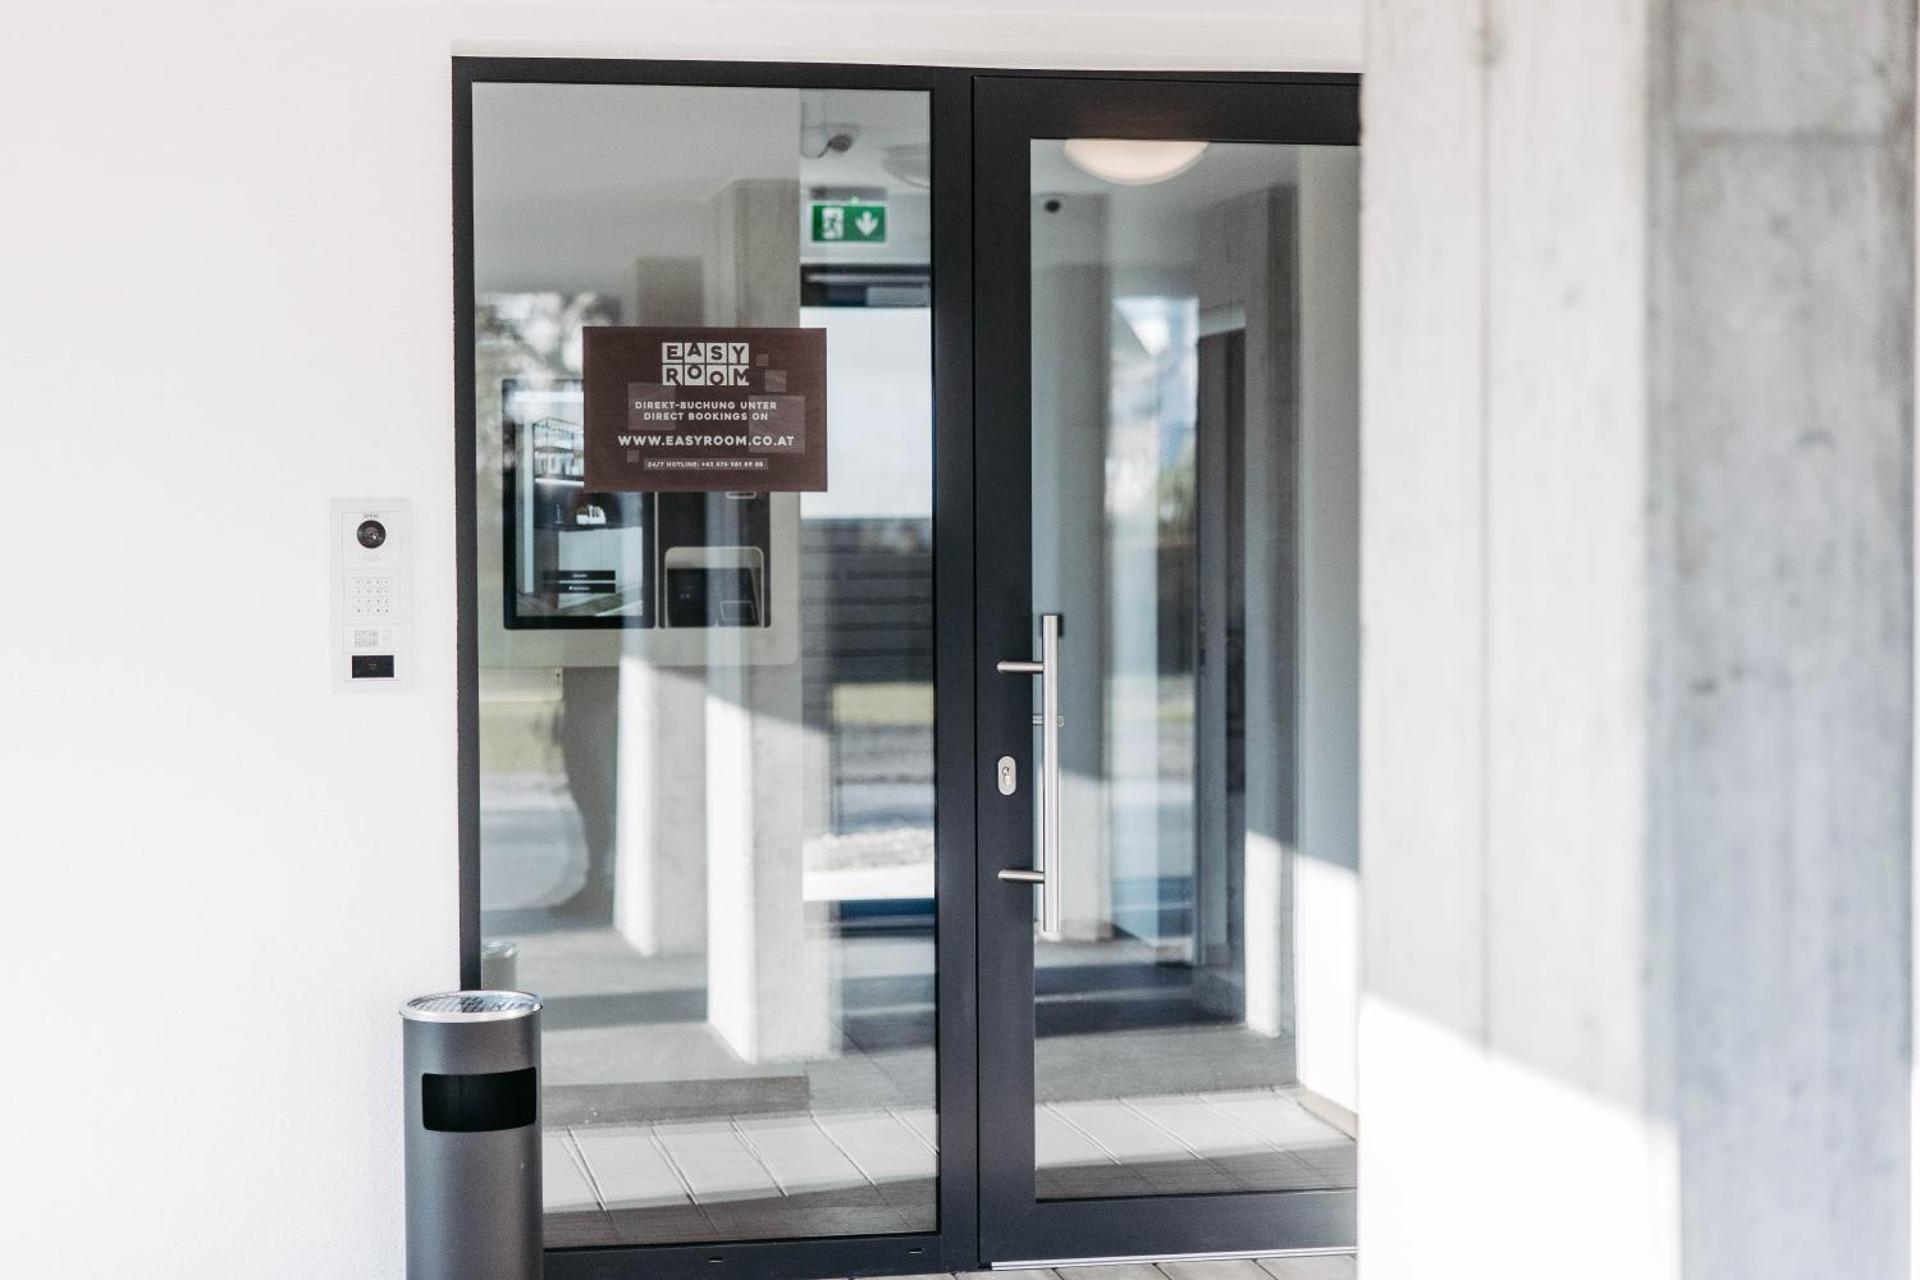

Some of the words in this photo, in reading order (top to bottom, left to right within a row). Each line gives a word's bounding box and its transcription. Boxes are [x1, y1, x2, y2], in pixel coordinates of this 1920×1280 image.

[663, 342, 749, 363] EASY
[663, 365, 750, 386] ROOM
[635, 401, 736, 410] DIREKT-BUCHUNG
[740, 401, 777, 410] UNTER
[643, 412, 684, 421] DIRECT
[688, 412, 748, 421] BOOKINGS
[752, 412, 769, 421] ON
[618, 435, 795, 447] WWW.EASYROOM.CO.AT
